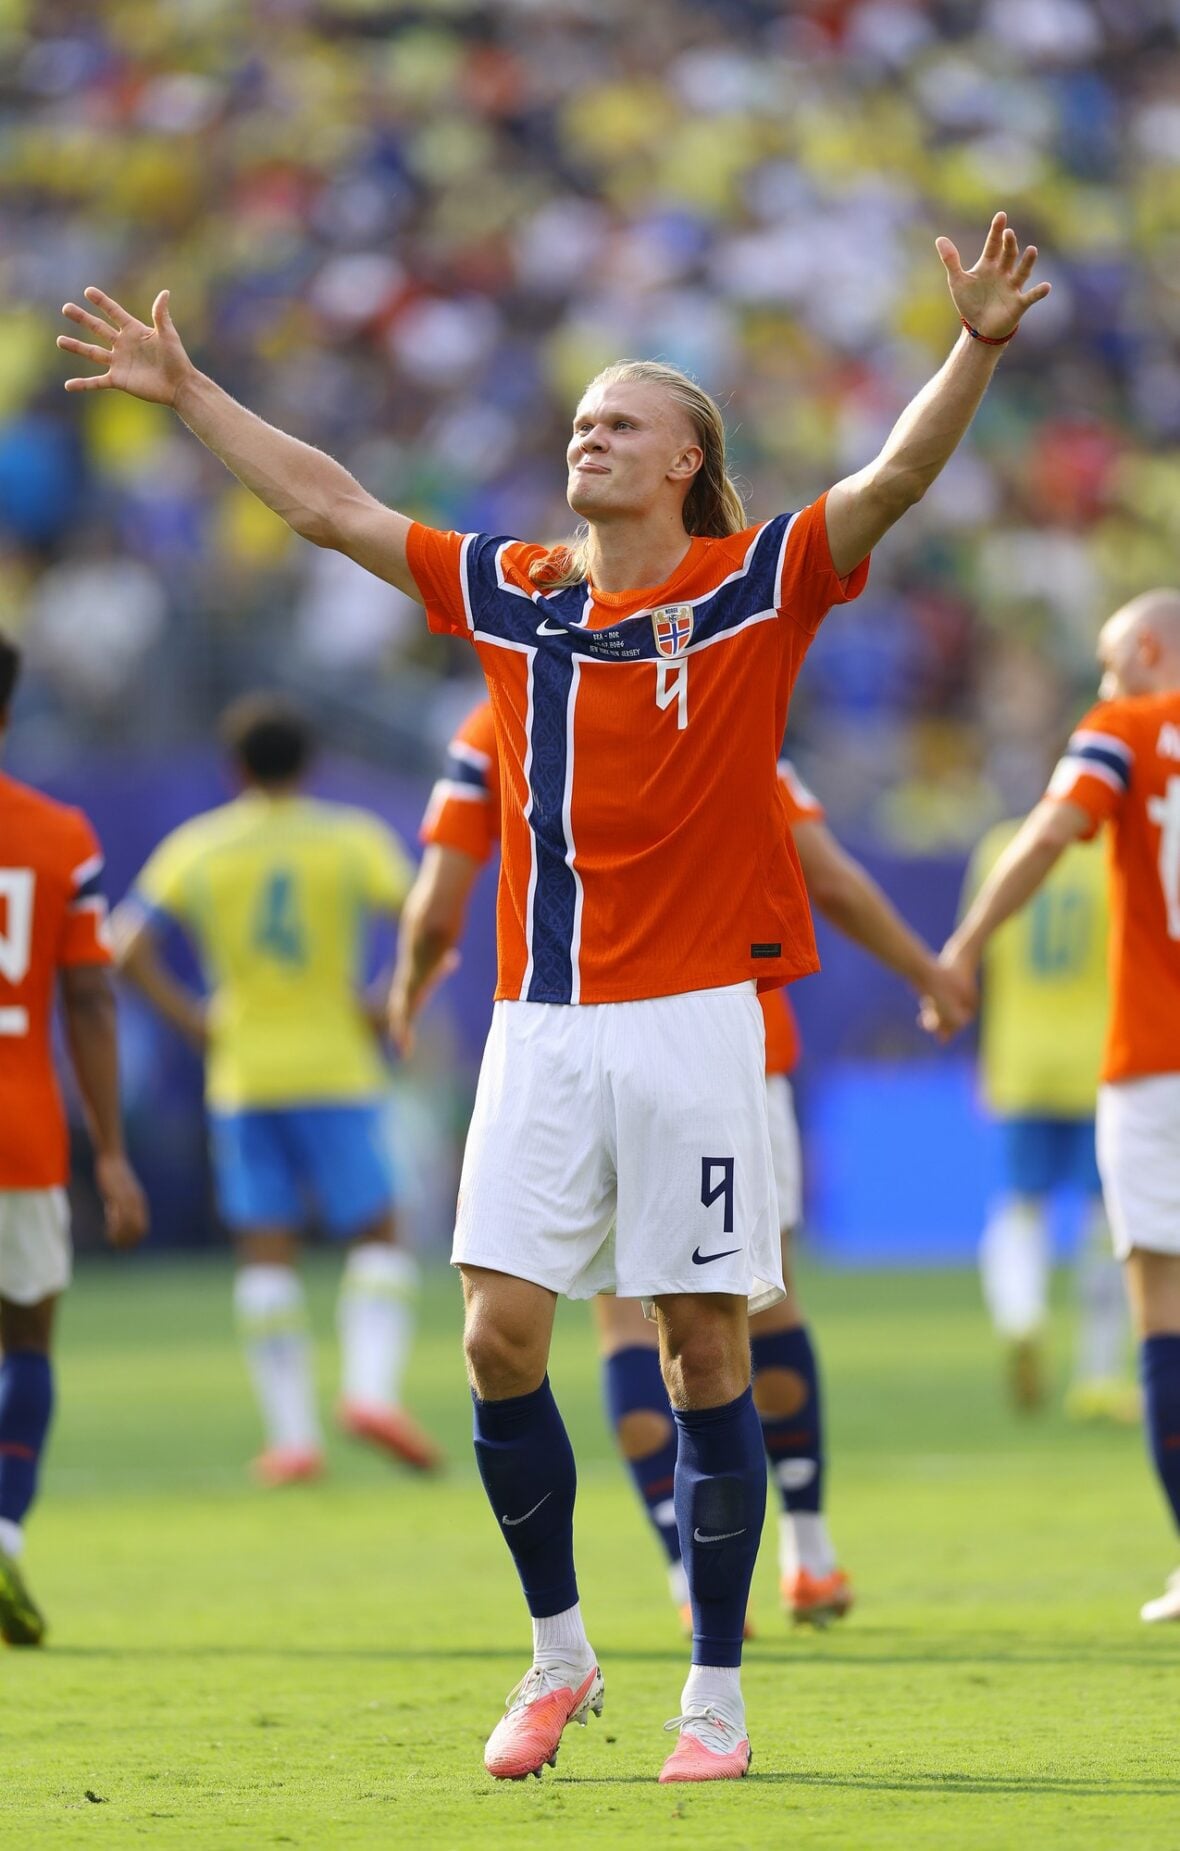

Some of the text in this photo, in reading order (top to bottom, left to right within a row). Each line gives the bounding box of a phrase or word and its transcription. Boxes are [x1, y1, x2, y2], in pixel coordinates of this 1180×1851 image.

[656, 657, 689, 730] 9
[252, 870, 304, 965] 4
[701, 1157, 734, 1233] 9
